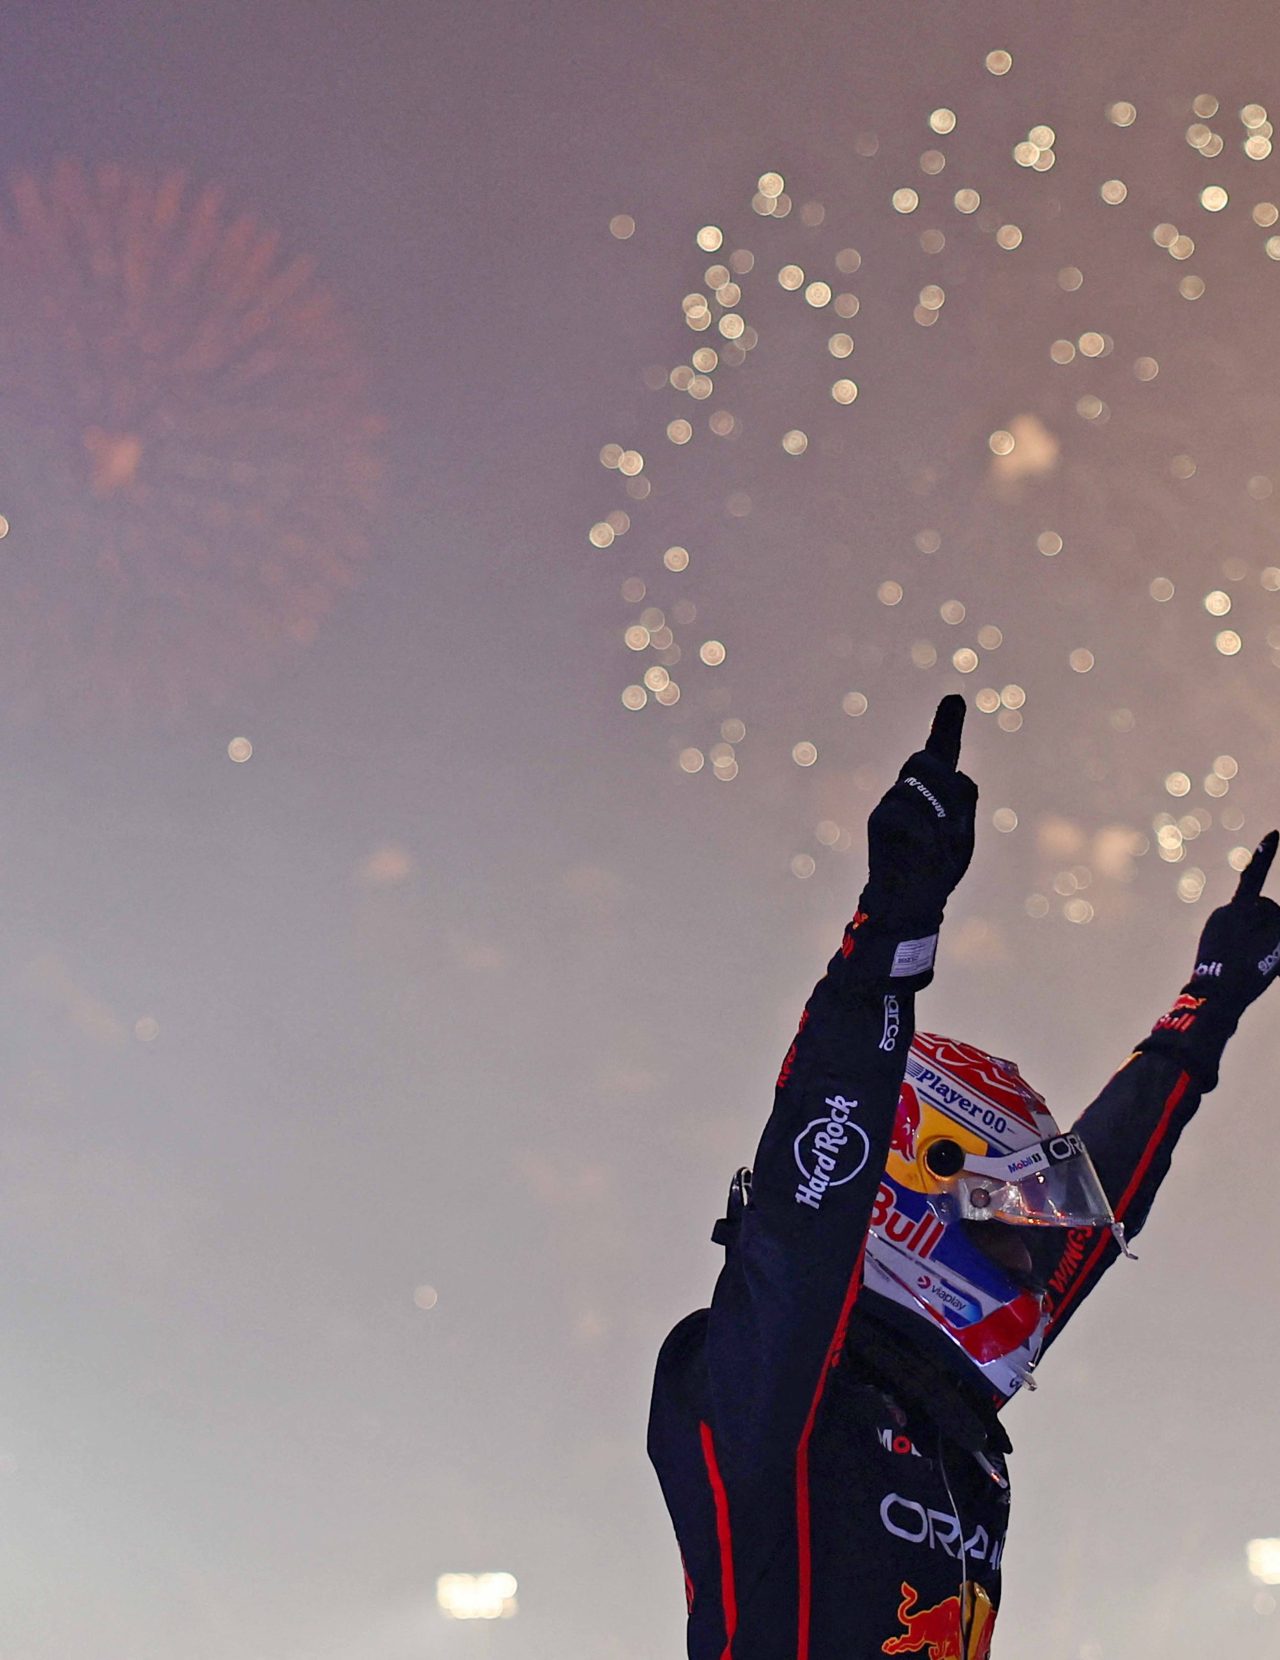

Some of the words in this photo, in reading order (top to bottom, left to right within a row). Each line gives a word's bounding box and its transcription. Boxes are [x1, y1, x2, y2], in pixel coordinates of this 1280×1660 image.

[1152, 1013, 1197, 1033] ull
[870, 1182, 945, 1259] Bull
[931, 1283, 967, 1311] viaplay
